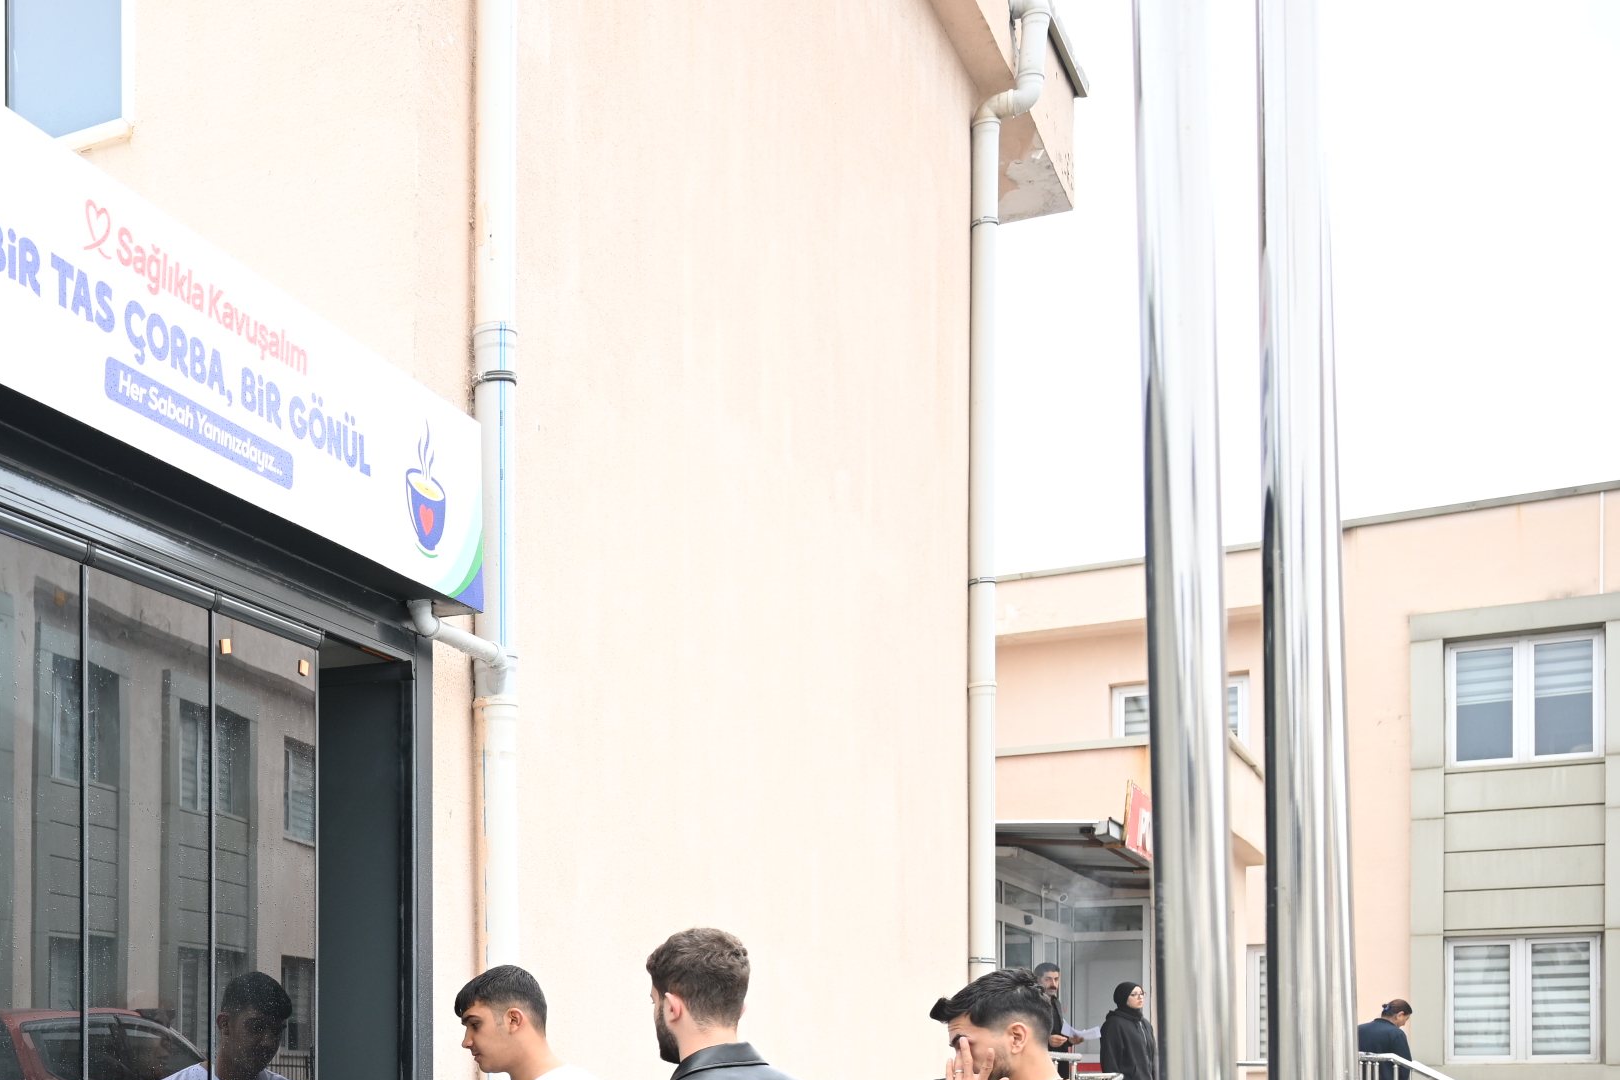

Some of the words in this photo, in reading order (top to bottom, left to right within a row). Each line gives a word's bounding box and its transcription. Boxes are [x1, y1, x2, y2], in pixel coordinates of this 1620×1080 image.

[51, 252, 115, 333] TAS
[124, 300, 232, 407] ÇORBA,
[289, 393, 371, 477] GÖNÜL
[116, 227, 204, 313] Sağlıkla
[208, 284, 307, 376] Kavuşalım
[119, 370, 147, 403] Her
[148, 386, 194, 429] Sabah
[196, 411, 282, 475] Yanınızdayız...
